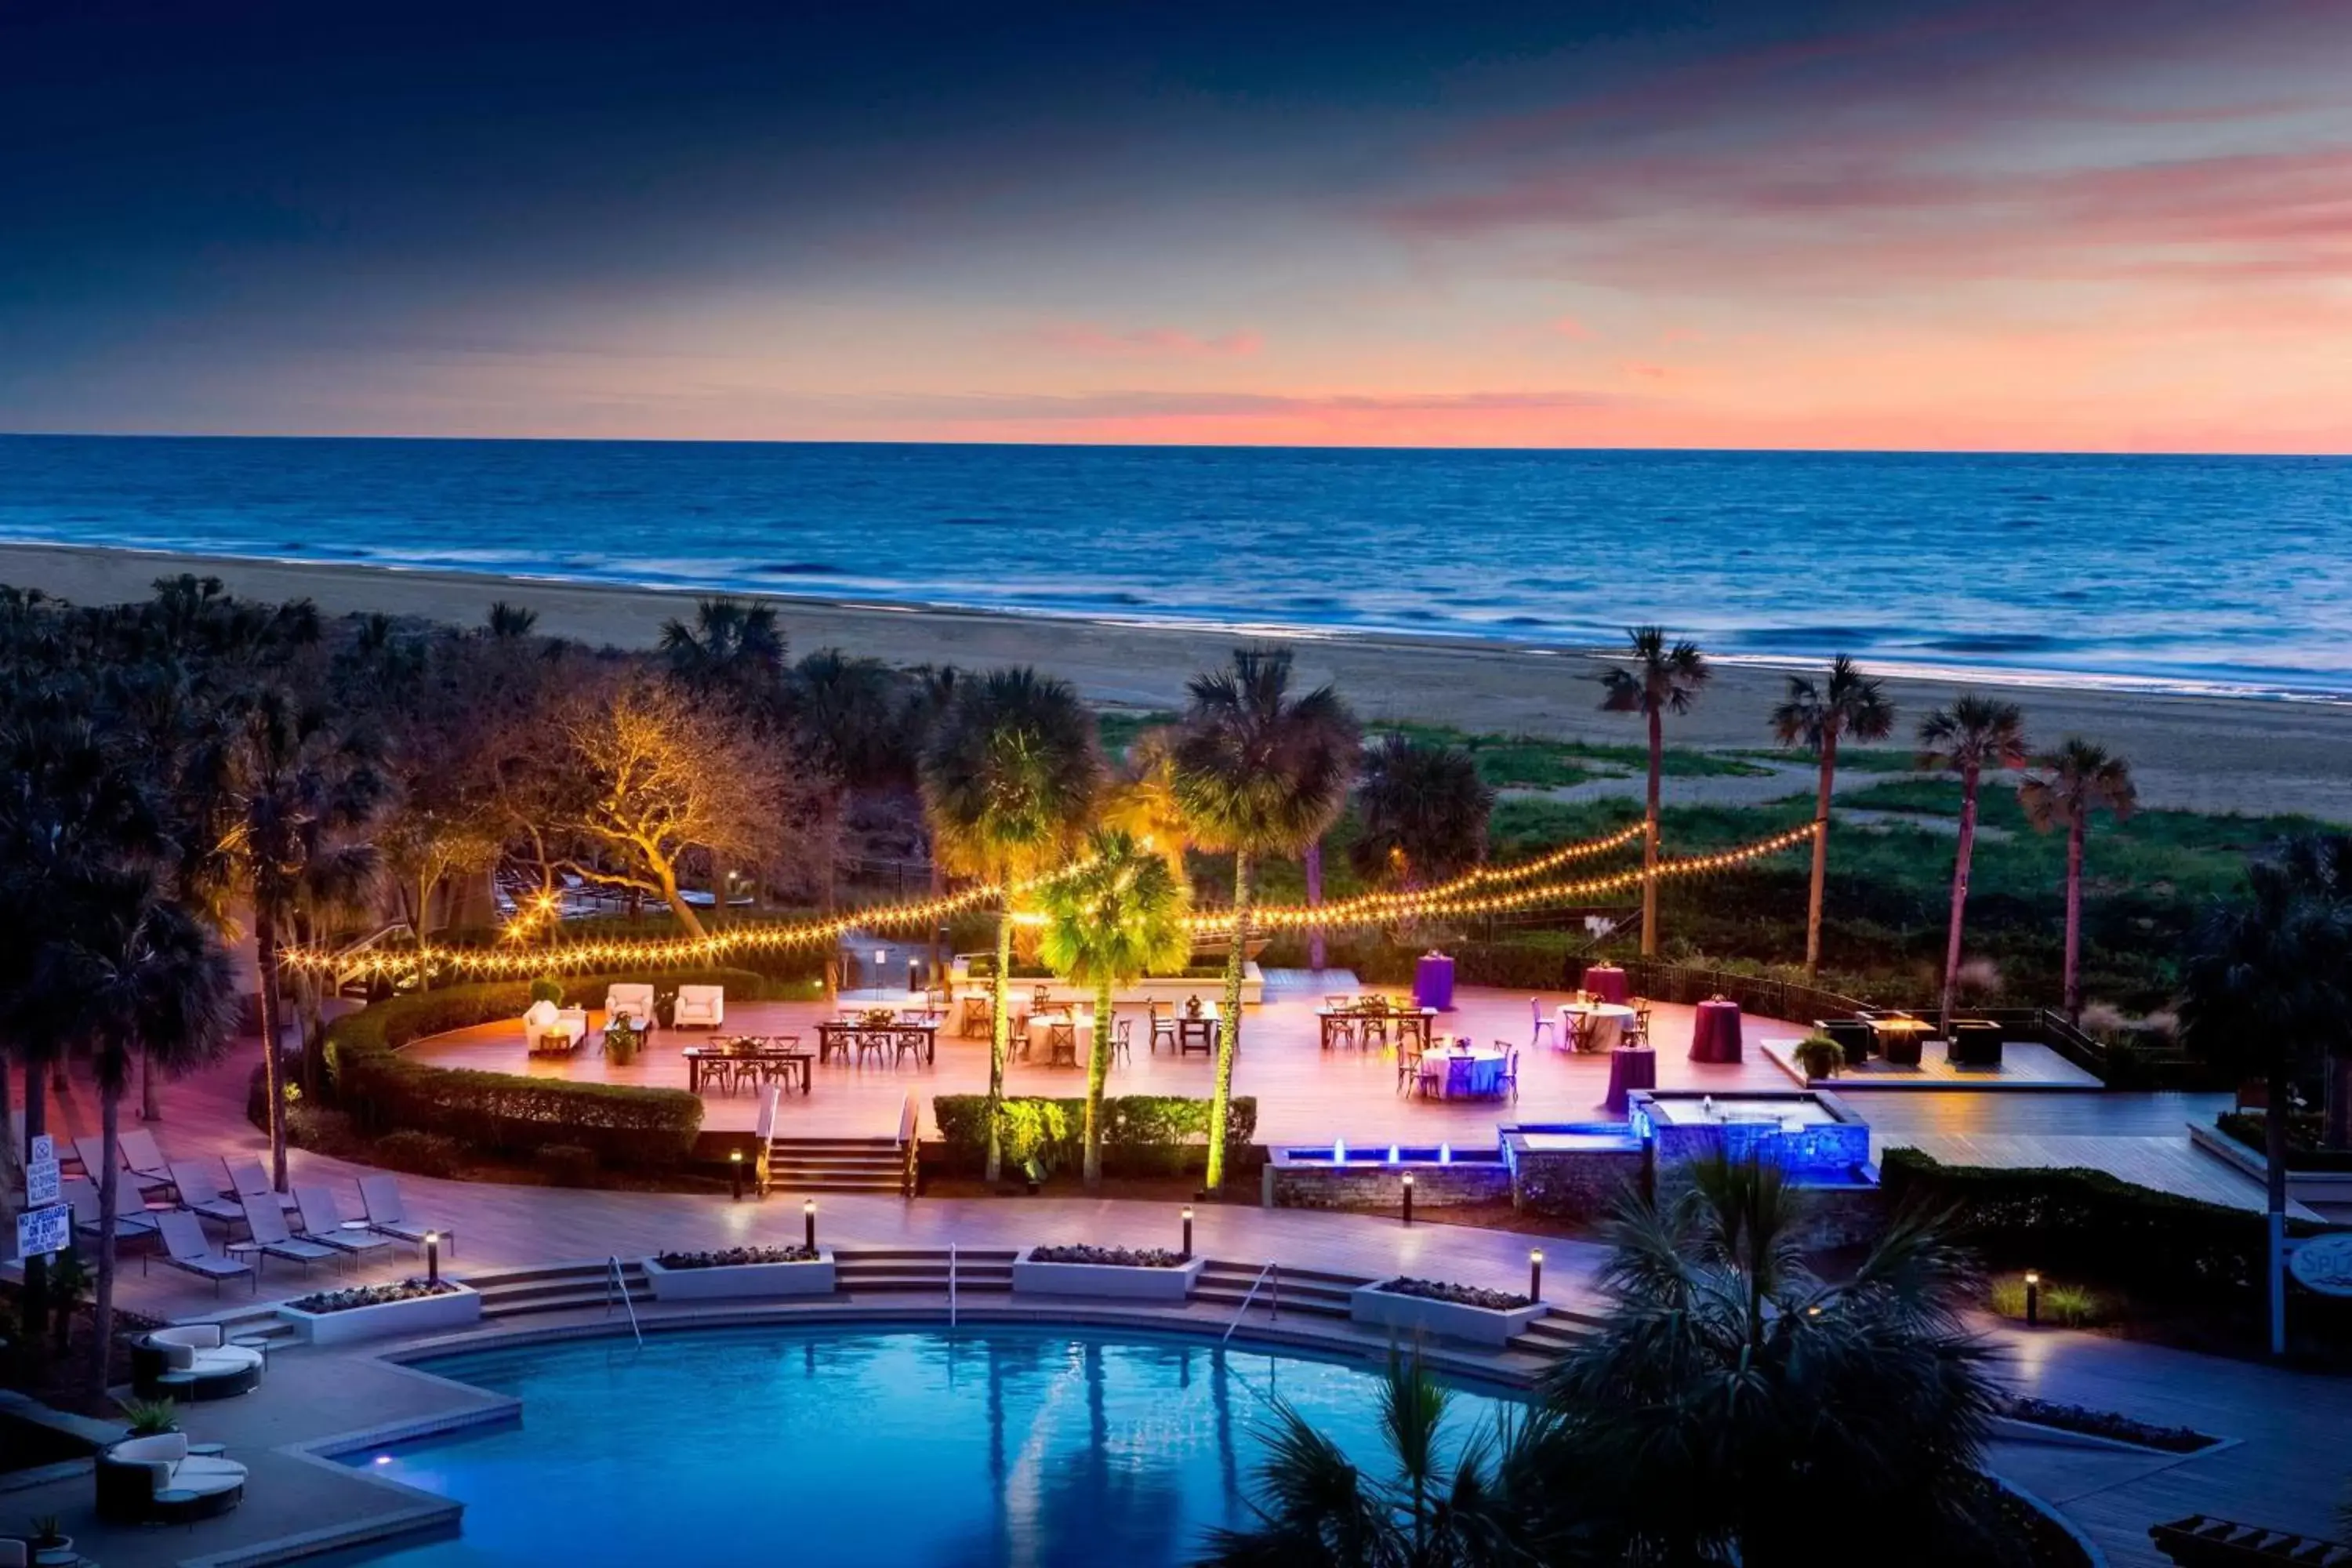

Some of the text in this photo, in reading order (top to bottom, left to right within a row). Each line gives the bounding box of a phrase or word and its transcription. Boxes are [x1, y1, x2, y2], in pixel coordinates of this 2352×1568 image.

[19, 1207, 66, 1227] NO LIFEGUARD
[30, 1221, 58, 1237] ON DUTY
[2299, 1249, 2352, 1276] SPL
